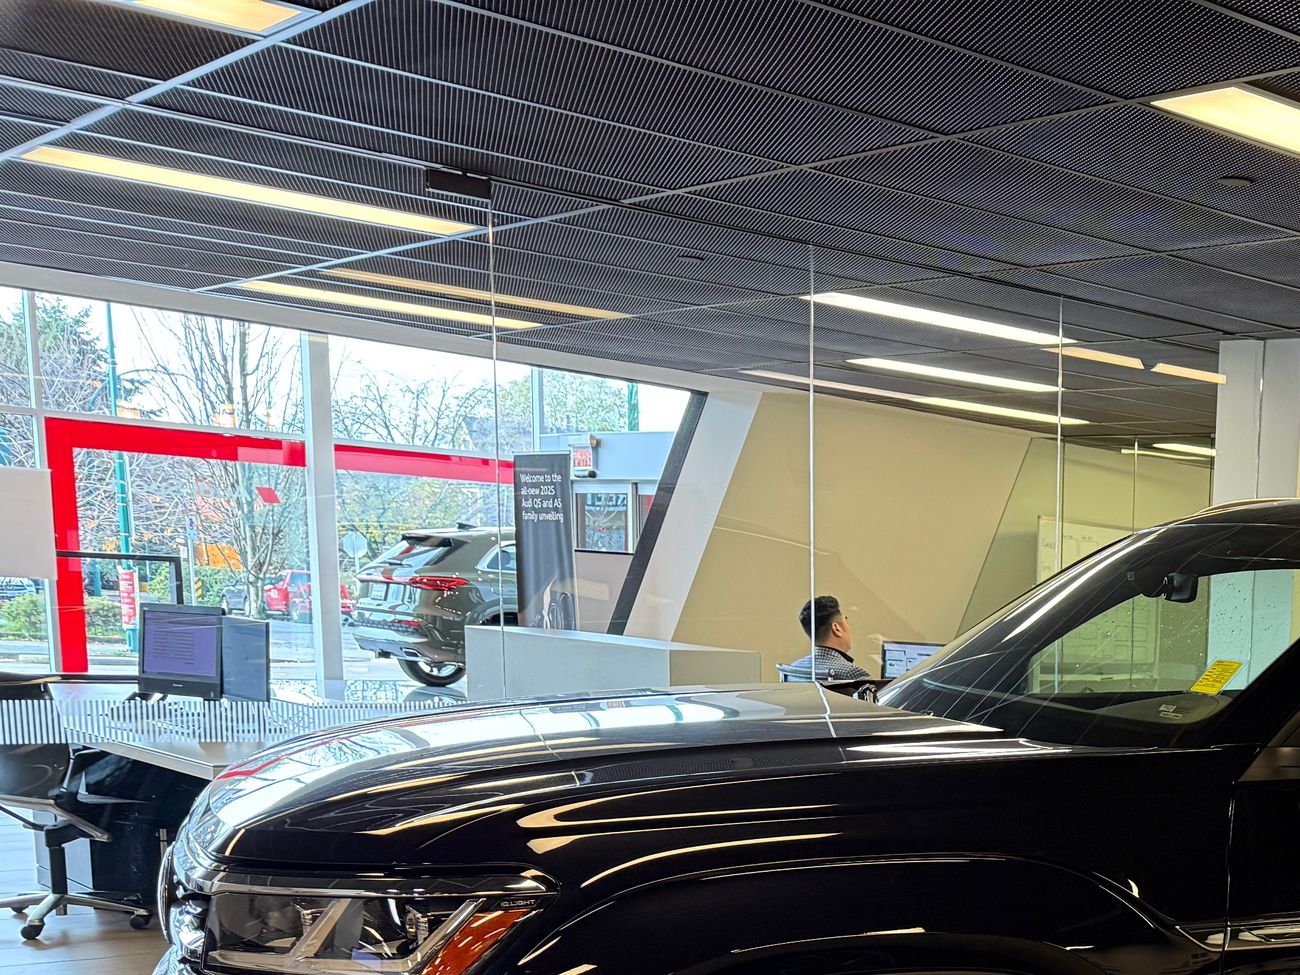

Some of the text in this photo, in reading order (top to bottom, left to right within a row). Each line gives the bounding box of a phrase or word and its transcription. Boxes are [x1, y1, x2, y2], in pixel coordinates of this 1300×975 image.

[520, 473, 562, 483] Welcome to the
[541, 485, 555, 495] 2025
[522, 498, 562, 509] Audi Q5 and A5
[523, 510, 564, 523] family unveiling
